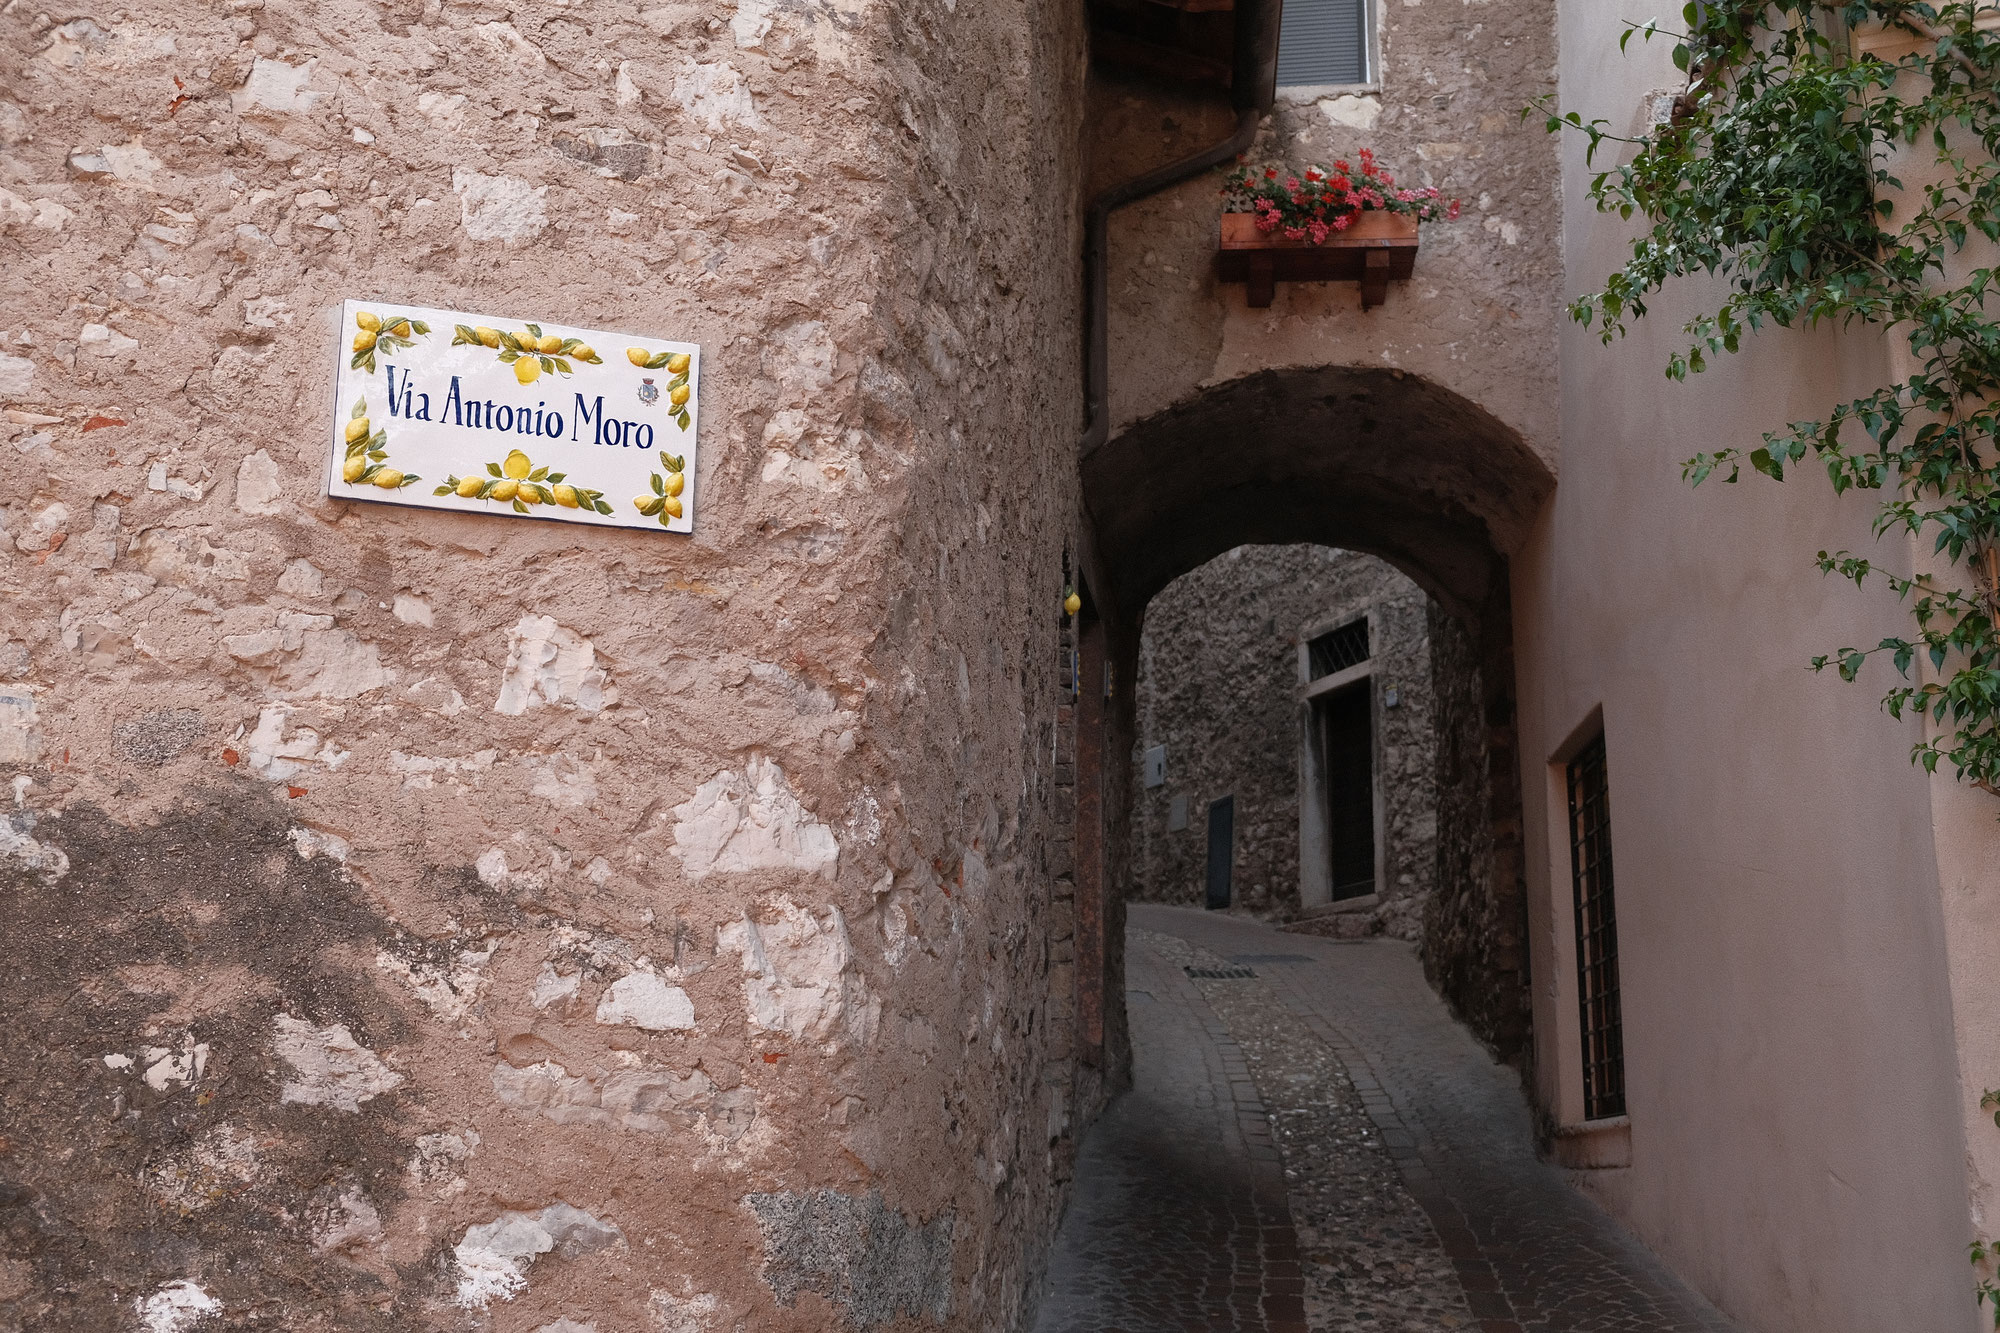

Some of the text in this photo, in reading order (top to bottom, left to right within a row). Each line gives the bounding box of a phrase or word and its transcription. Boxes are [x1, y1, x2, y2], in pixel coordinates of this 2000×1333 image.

[385, 364, 654, 449] Via Antonio Moro
